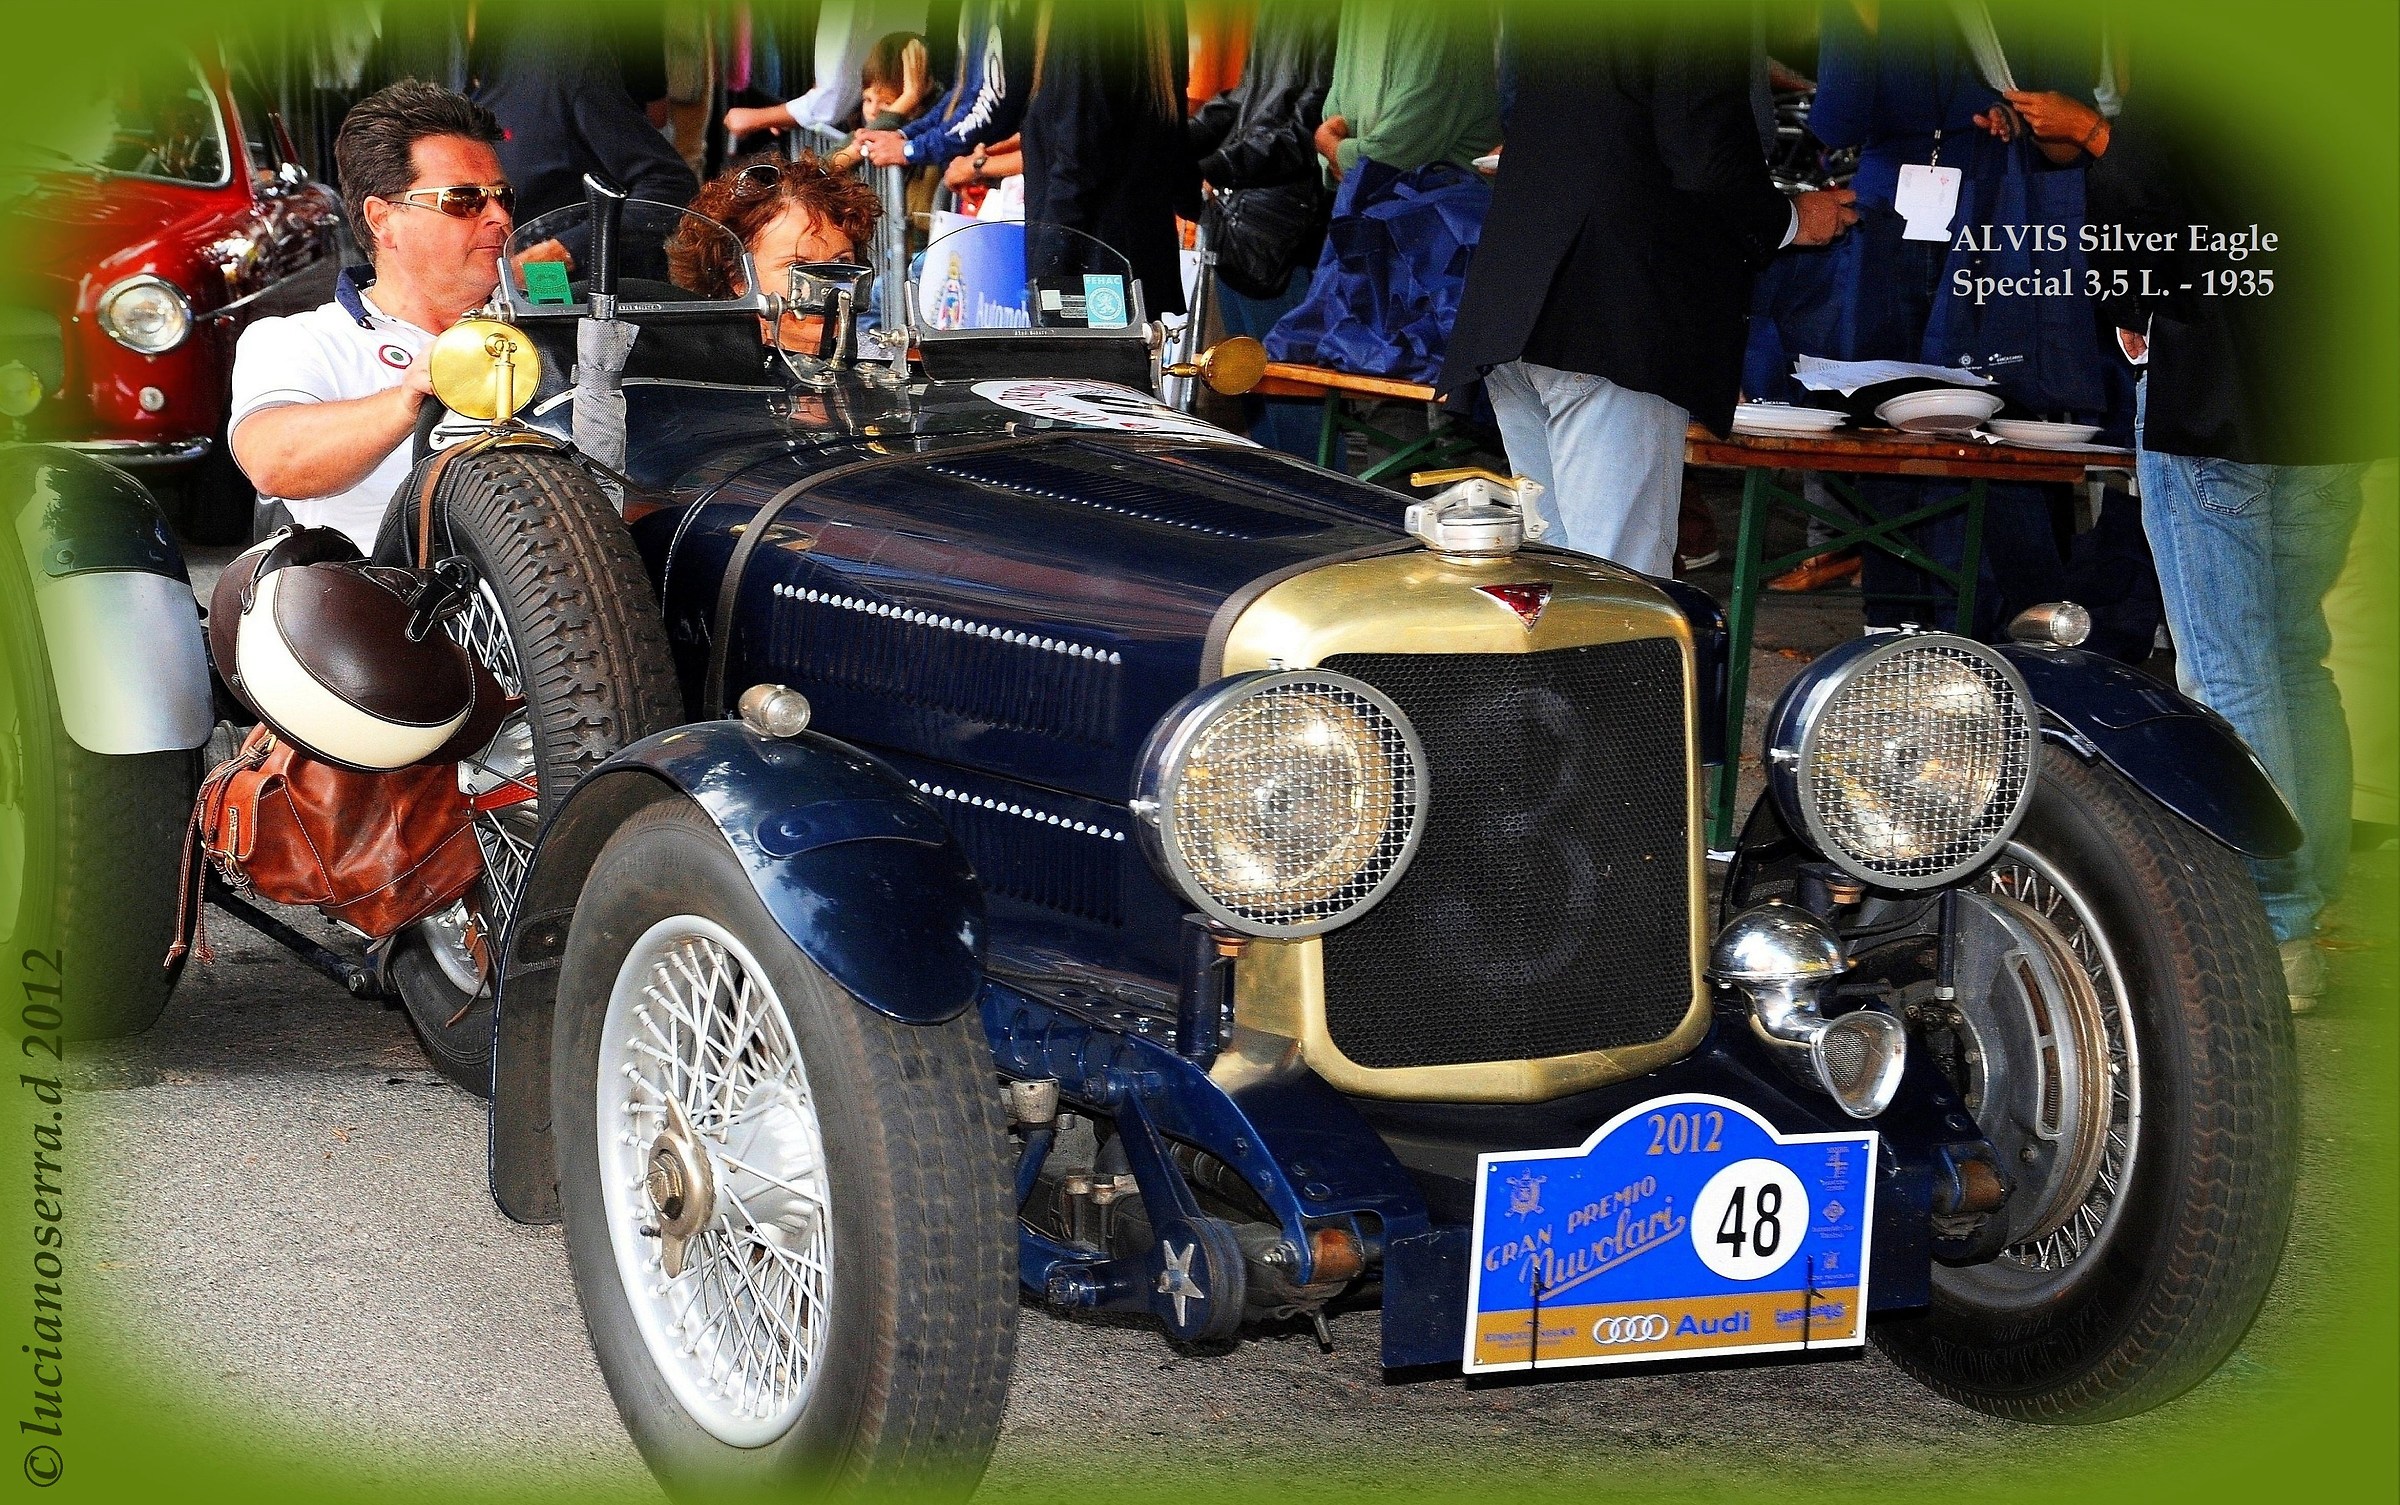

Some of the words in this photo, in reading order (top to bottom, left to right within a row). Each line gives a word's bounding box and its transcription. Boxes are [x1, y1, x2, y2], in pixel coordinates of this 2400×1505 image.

[1085, 276, 1121, 285] FEHAC
[1647, 1110, 1724, 1156] 2012
[1485, 1224, 1553, 1272] GRAN
[1567, 1175, 1658, 1234] PREMIO
[1518, 1196, 1678, 1298] Nuvolari
[1716, 1183, 1783, 1258] 48
[1674, 1310, 1752, 1337] Audi
